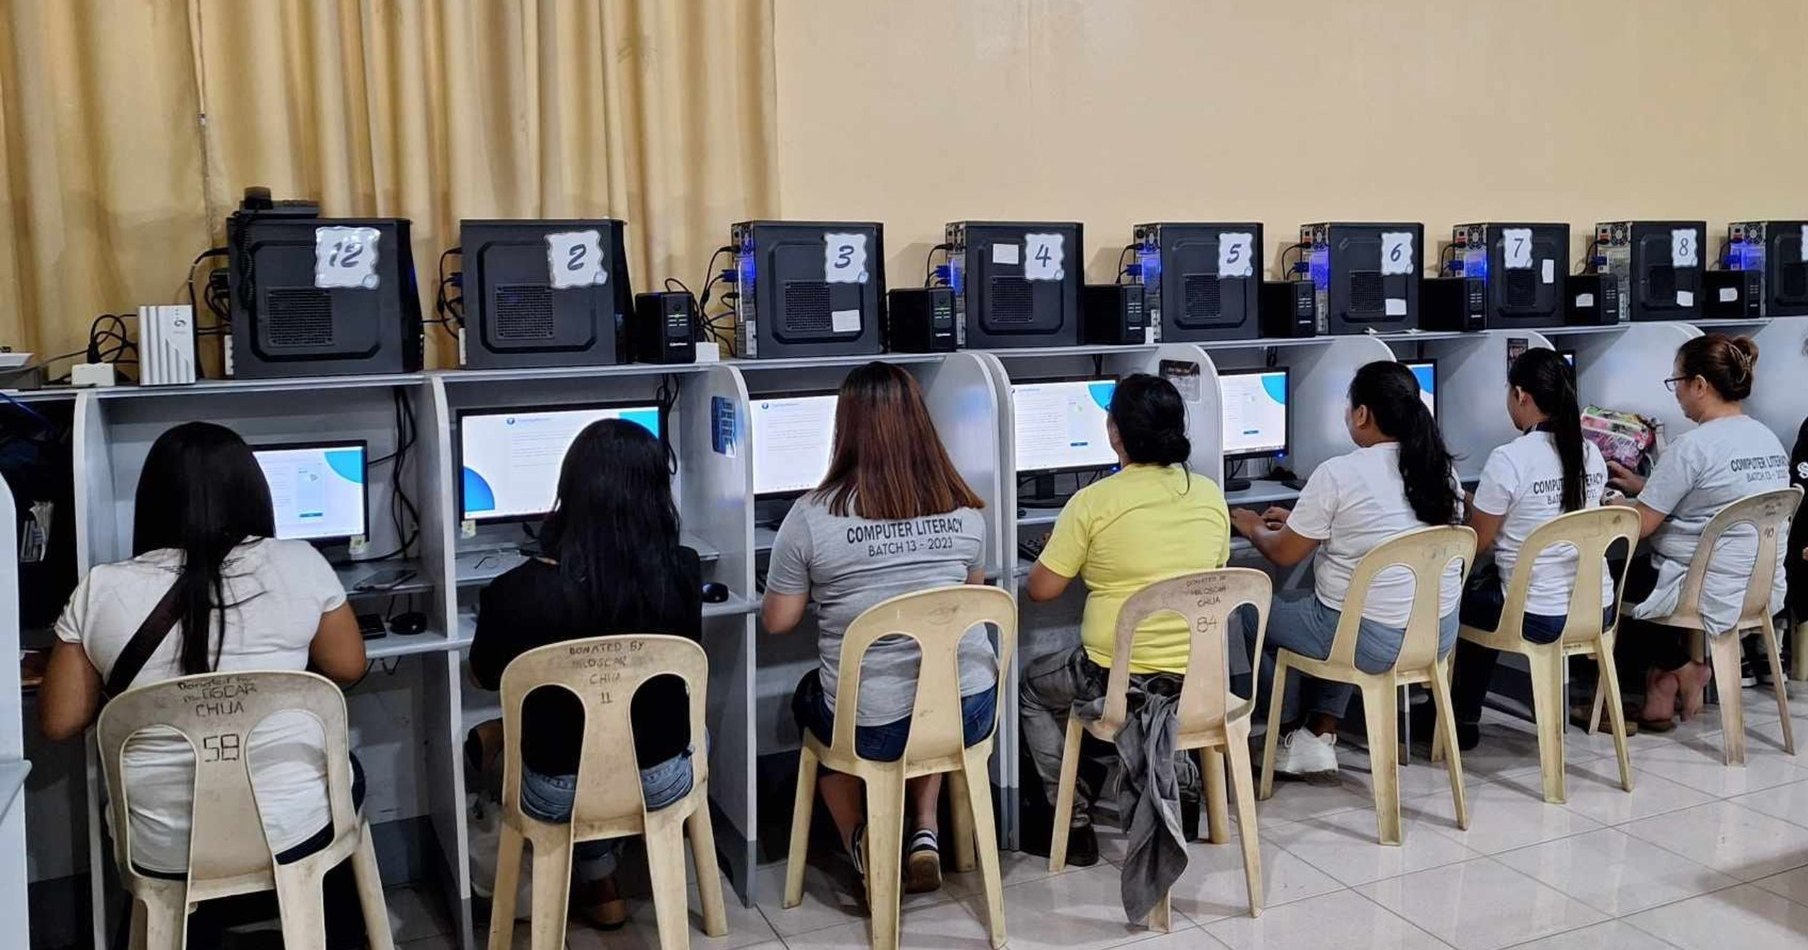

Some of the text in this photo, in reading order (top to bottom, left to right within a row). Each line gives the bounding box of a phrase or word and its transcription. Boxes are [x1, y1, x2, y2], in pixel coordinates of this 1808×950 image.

[328, 241, 363, 268] 12
[567, 243, 587, 271] 2
[834, 245, 854, 269] 3
[1034, 243, 1052, 268] 4
[1226, 243, 1242, 264] 5
[1390, 242, 1404, 262] 6
[1513, 238, 1525, 258] 7
[1679, 238, 1691, 257] 8
[1730, 455, 1765, 472] COMPUTER
[846, 518, 963, 544] COMPUTER LITERACY
[868, 542, 904, 557] BATCH
[906, 540, 917, 552] 13
[928, 536, 953, 550] 2023
[1197, 614, 1218, 633] 84
[569, 640, 645, 655] DONATED BY
[195, 701, 244, 717] CHUA
[203, 733, 240, 762] 58
